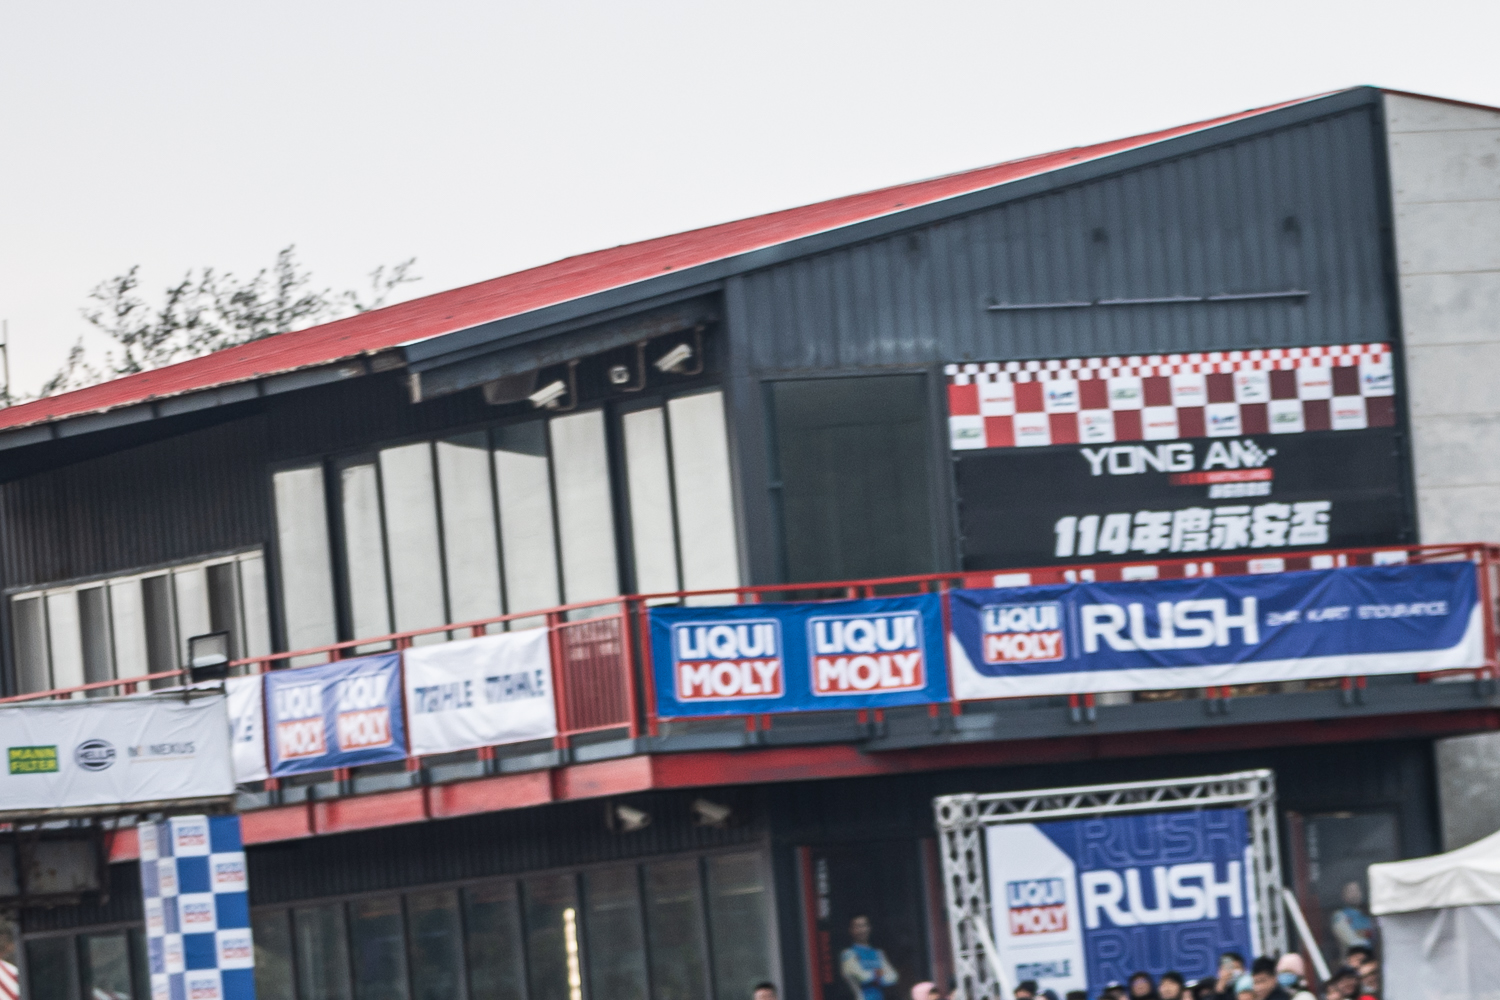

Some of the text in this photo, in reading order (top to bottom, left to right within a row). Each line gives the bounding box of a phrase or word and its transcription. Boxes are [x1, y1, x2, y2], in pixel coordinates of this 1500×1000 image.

[1081, 443, 1195, 476] YONG
[815, 616, 918, 654] LIQUI
[986, 606, 1058, 633] LIQUI
[1081, 597, 1260, 653] RUSH
[678, 624, 776, 660] LIQUI
[986, 633, 1061, 661] MOLY
[680, 660, 779, 696] MOLY
[817, 652, 920, 690] MOLY
[1081, 860, 1244, 929] RUSH
